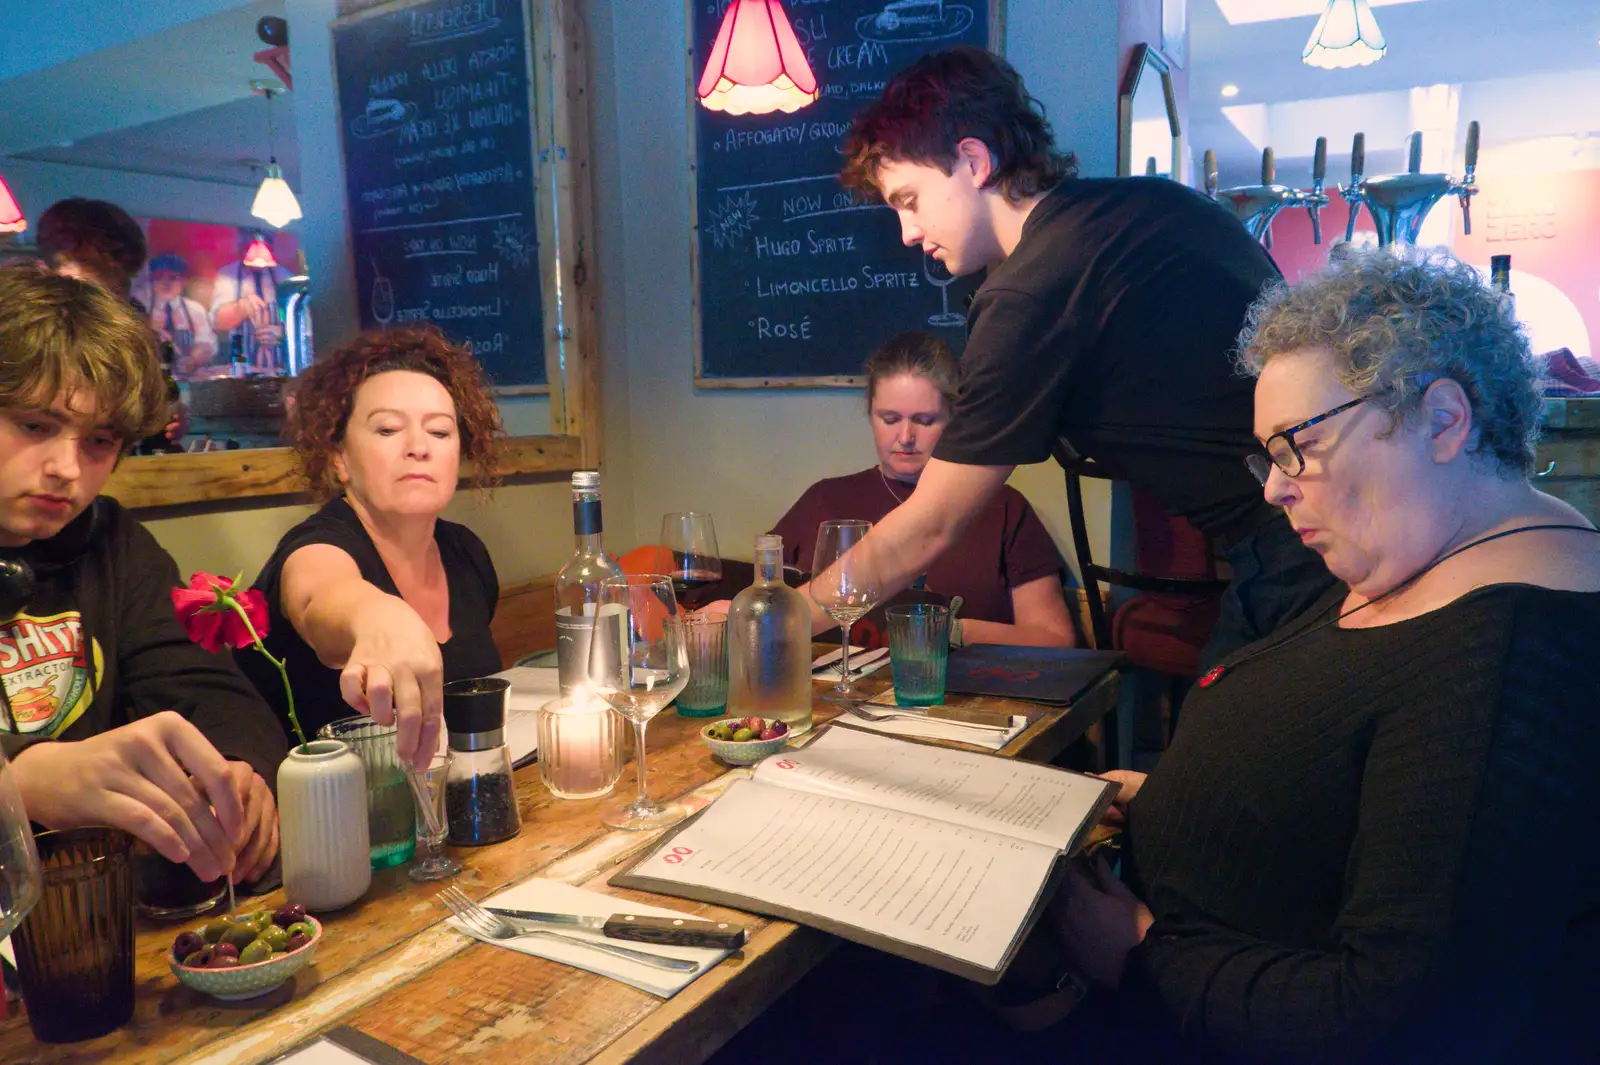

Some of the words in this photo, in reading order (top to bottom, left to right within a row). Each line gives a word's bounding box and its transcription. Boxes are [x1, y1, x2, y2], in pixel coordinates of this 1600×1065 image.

[827, 42, 888, 69] CREAM
[783, 194, 822, 216] NOW
[832, 190, 854, 209] ON
[720, 209, 742, 231] NEW
[755, 235, 801, 259] HUGO
[806, 229, 857, 254] SPRITZ
[756, 276, 858, 298] LIMONCELLO
[862, 266, 920, 289] SPRITZ
[758, 314, 813, 340] ROSÉ
